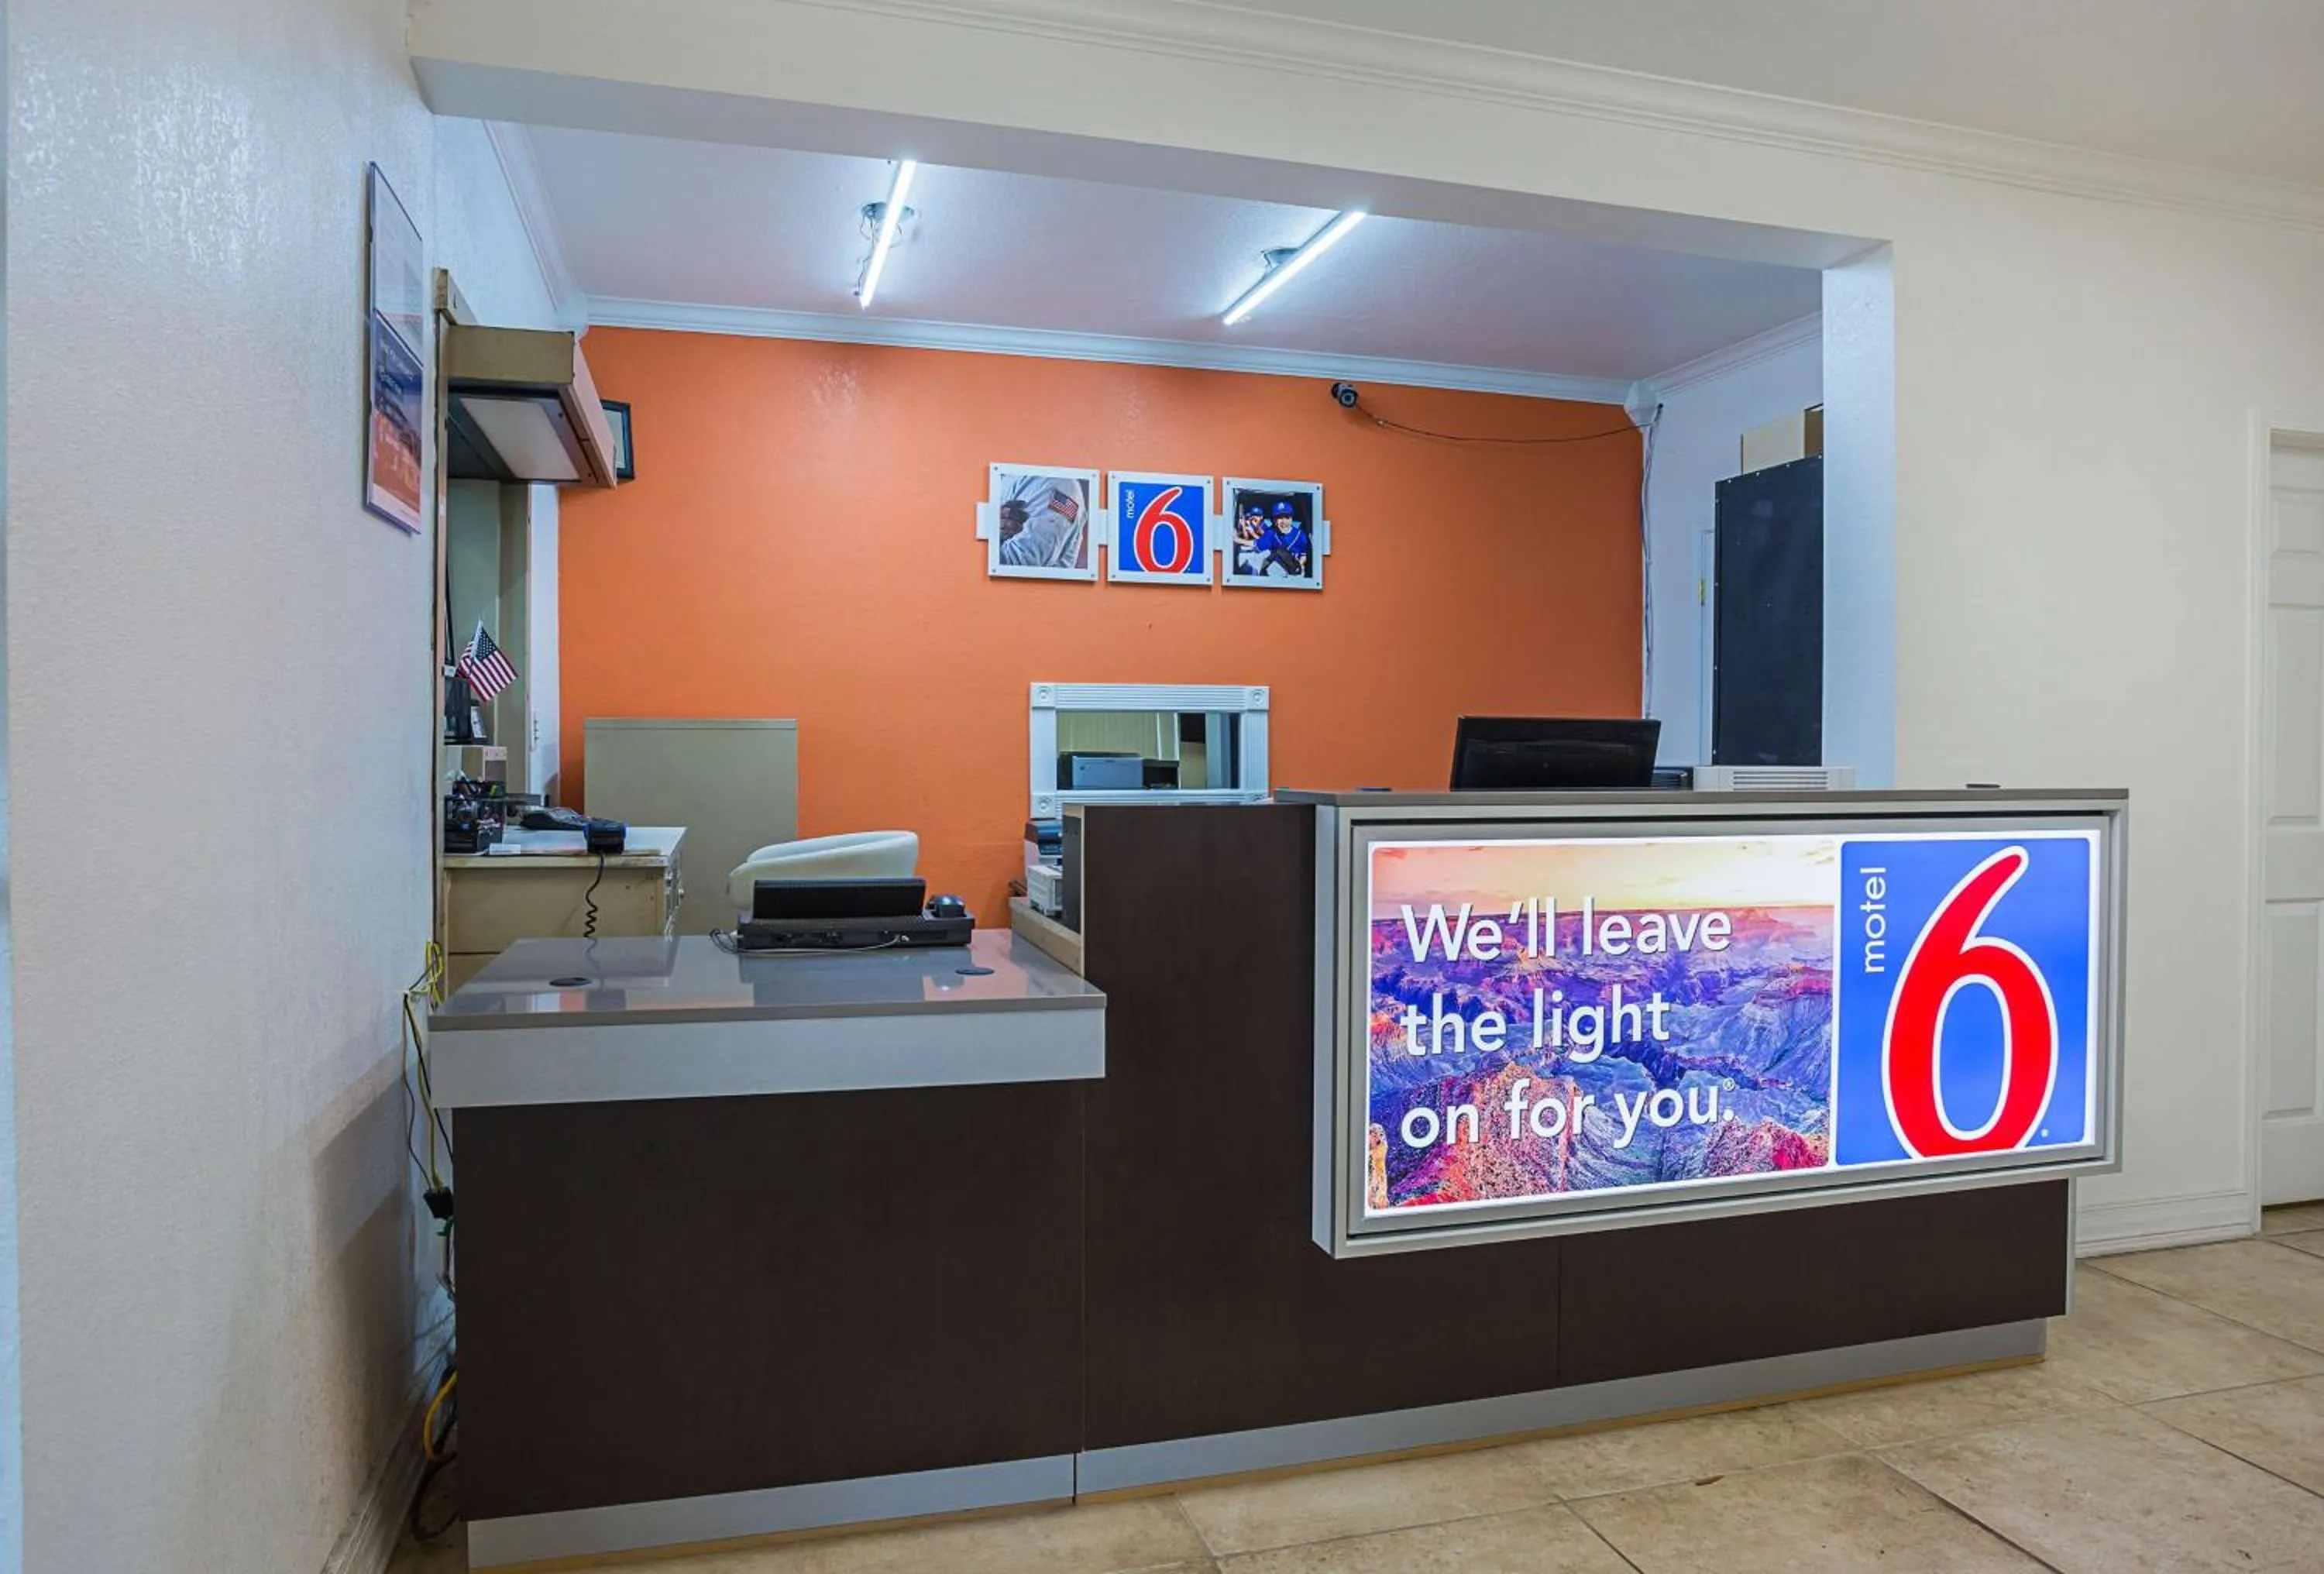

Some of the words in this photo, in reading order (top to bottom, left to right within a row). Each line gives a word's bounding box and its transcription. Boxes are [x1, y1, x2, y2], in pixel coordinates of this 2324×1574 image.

[1126, 490, 1134, 518] motel
[1134, 486, 1193, 573] 6
[1401, 895, 1556, 964] We'll
[1582, 895, 1732, 956] leave
[1400, 992, 1507, 1057] the
[1533, 984, 1670, 1064] light
[1860, 867, 1886, 973] motel
[1881, 845, 2059, 1160] 6
[1401, 1100, 1479, 1149] on
[1504, 1077, 1596, 1140] for
